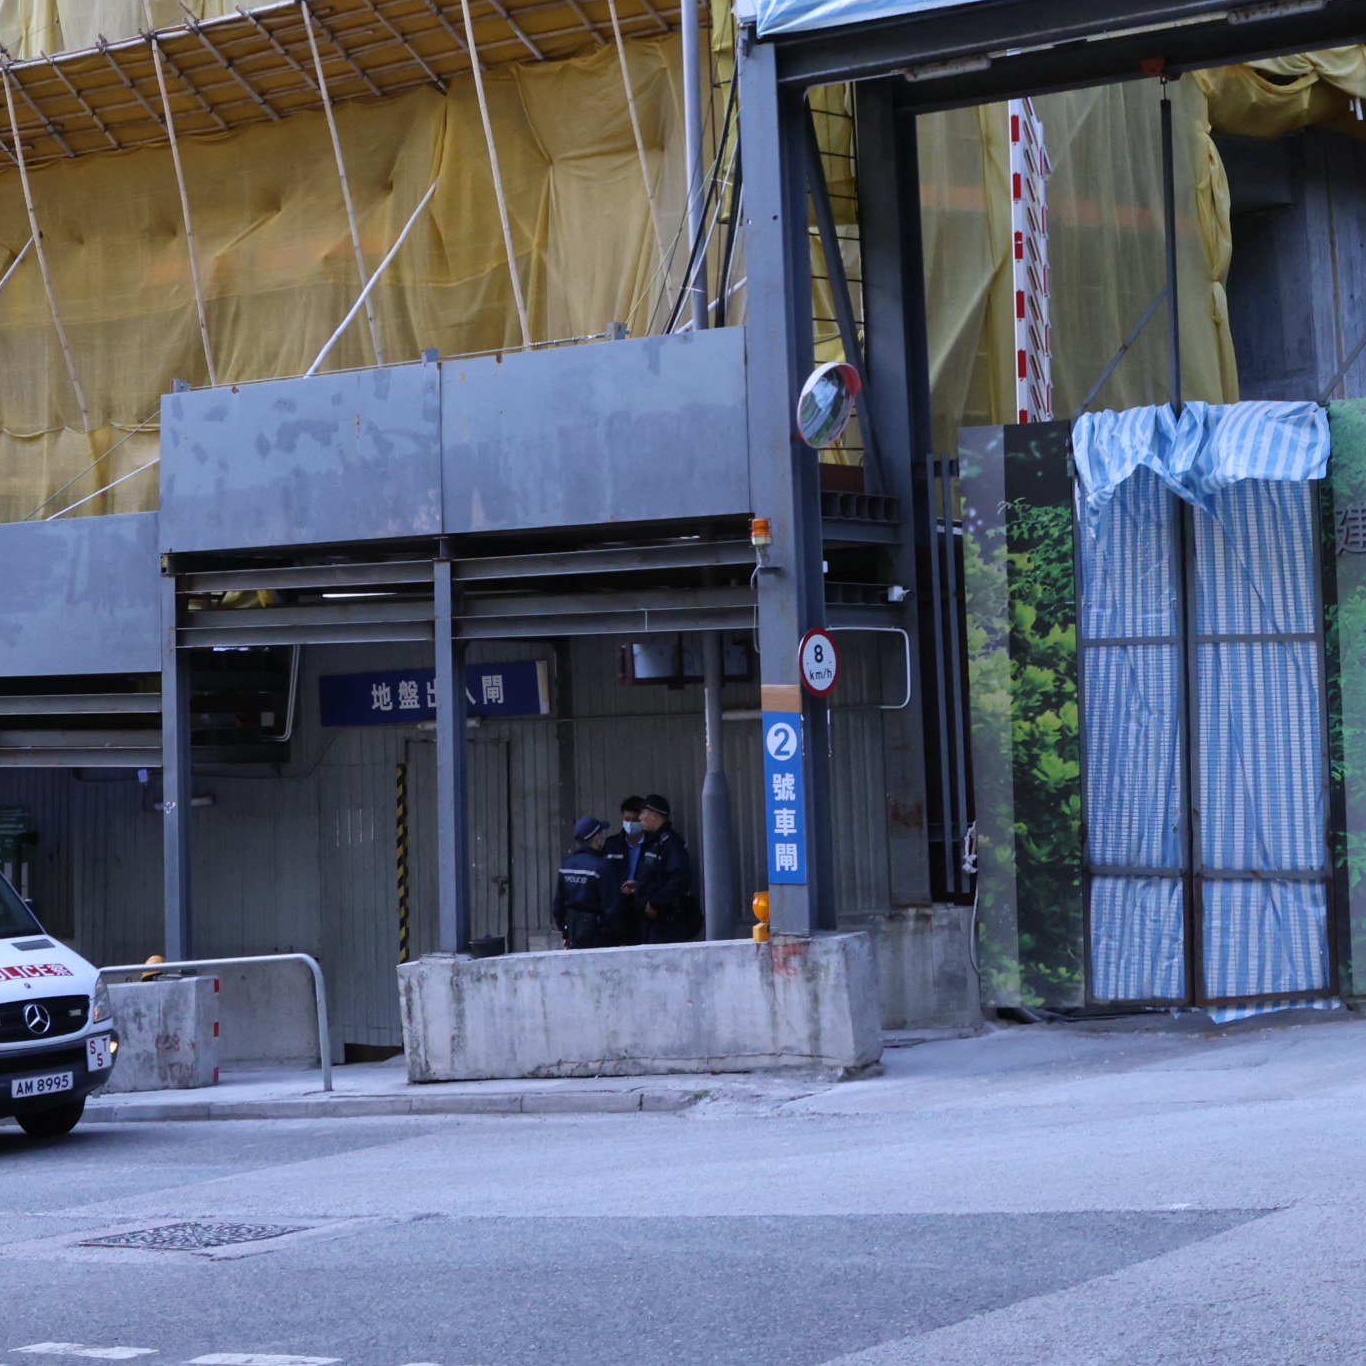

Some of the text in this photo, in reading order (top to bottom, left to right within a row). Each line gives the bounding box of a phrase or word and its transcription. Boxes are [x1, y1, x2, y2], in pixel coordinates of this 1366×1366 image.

[814, 644, 823, 663] 8
[809, 668, 833, 681] km/h
[97, 1053, 104, 1067] 5
[16, 1075, 69, 1096] AM 8995
